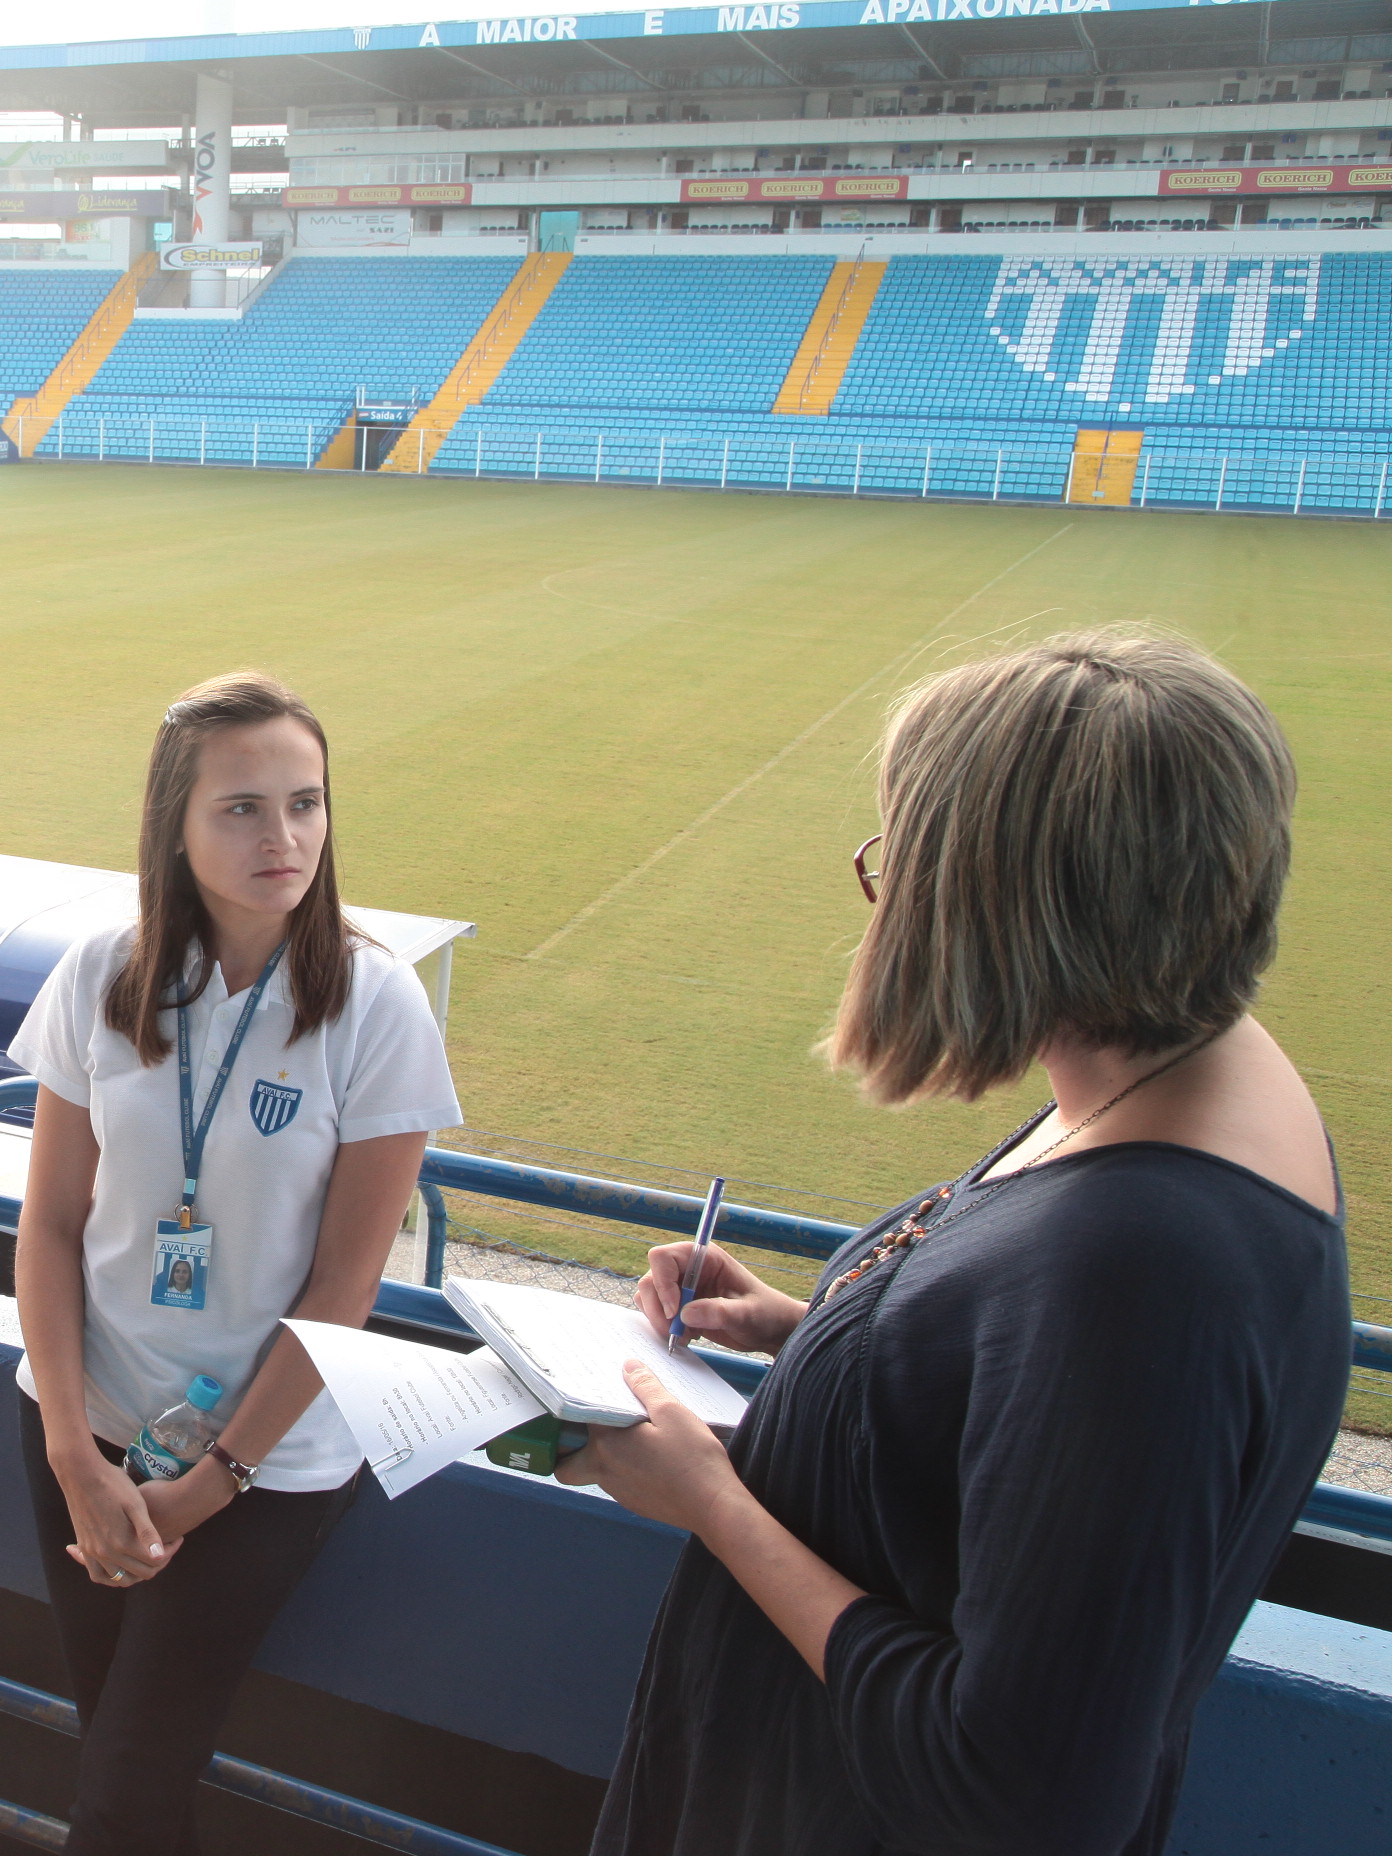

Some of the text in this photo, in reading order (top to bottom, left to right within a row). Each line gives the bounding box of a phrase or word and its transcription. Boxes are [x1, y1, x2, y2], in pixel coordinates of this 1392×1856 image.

[418, 23, 440, 47] A
[476, 16, 577, 44] MAIOR
[644, 11, 664, 35] E
[717, 4, 800, 32] MAIS
[1174, 176, 1236, 185] KOERICH
[1263, 174, 1327, 183] KOERICH
[692, 185, 745, 194] KOERICH
[766, 184, 819, 193] KOERICH
[840, 182, 895, 192] KOERICH
[310, 215, 396, 225] MALTEC
[181, 248, 260, 262] Schnel
[370, 410, 395, 420] Saída
[164, 1292, 192, 1301] FERNANDA
[408, 1413, 414, 1421] no
[411, 1421, 427, 1442] Horário
[144, 1453, 178, 1479] crystal
